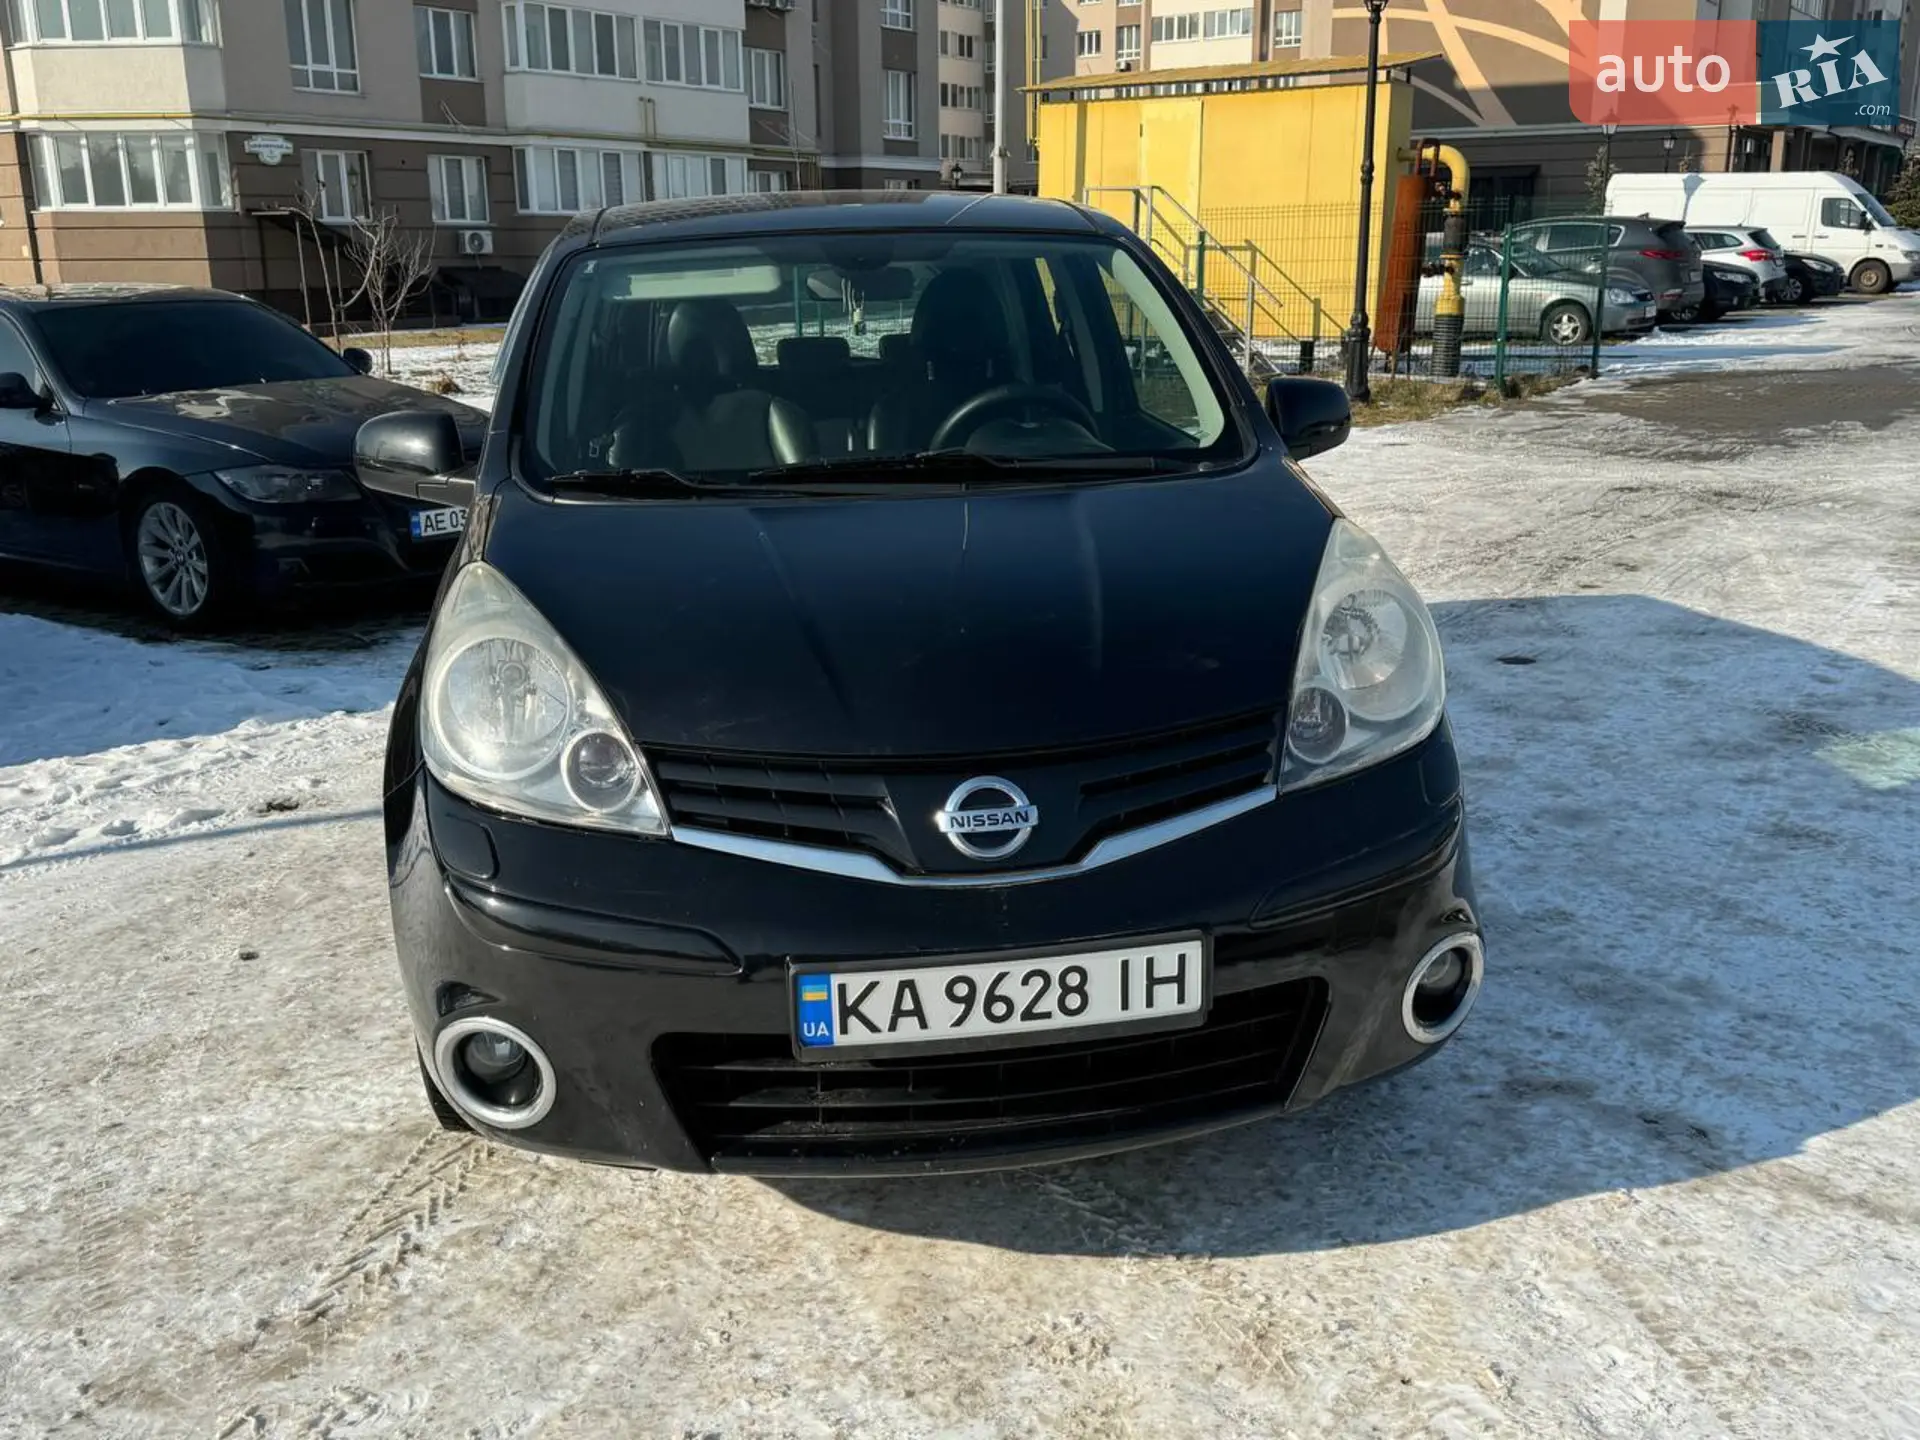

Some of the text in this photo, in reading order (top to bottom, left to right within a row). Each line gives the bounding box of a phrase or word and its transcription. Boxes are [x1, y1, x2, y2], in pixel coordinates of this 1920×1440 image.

[424, 512, 447, 533] AE
[950, 810, 1030, 828] NISSAN
[836, 952, 1187, 1036] KA 9628 IH
[803, 1022, 829, 1038] UA
